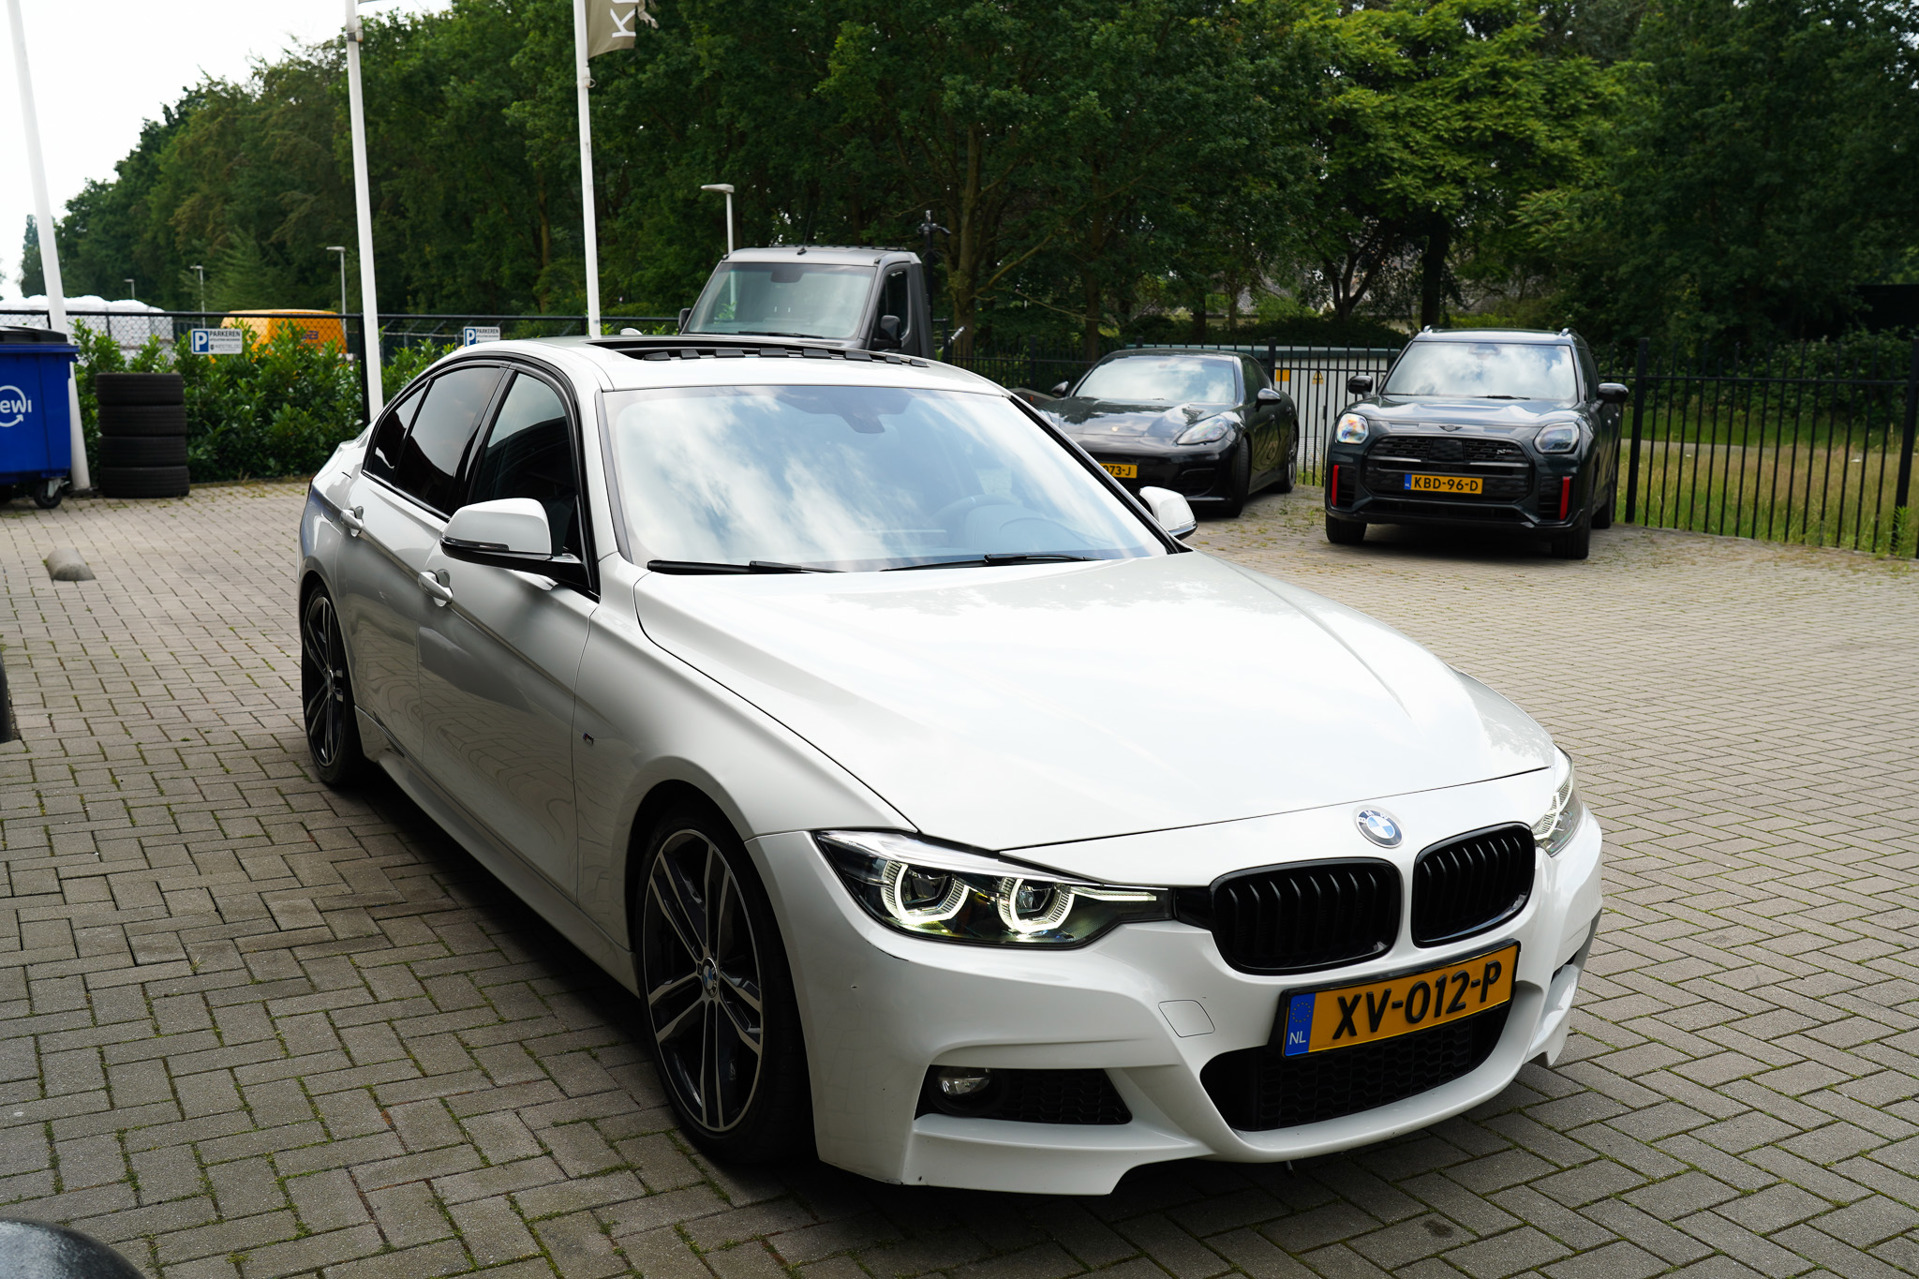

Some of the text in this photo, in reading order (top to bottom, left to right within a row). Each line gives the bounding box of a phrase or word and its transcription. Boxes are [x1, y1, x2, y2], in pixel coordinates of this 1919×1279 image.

[610, 0, 638, 38] K
[1414, 477, 1478, 492] KBD-96-D
[1332, 960, 1502, 1040] XV-012-P
[1289, 1031, 1306, 1045] NL
